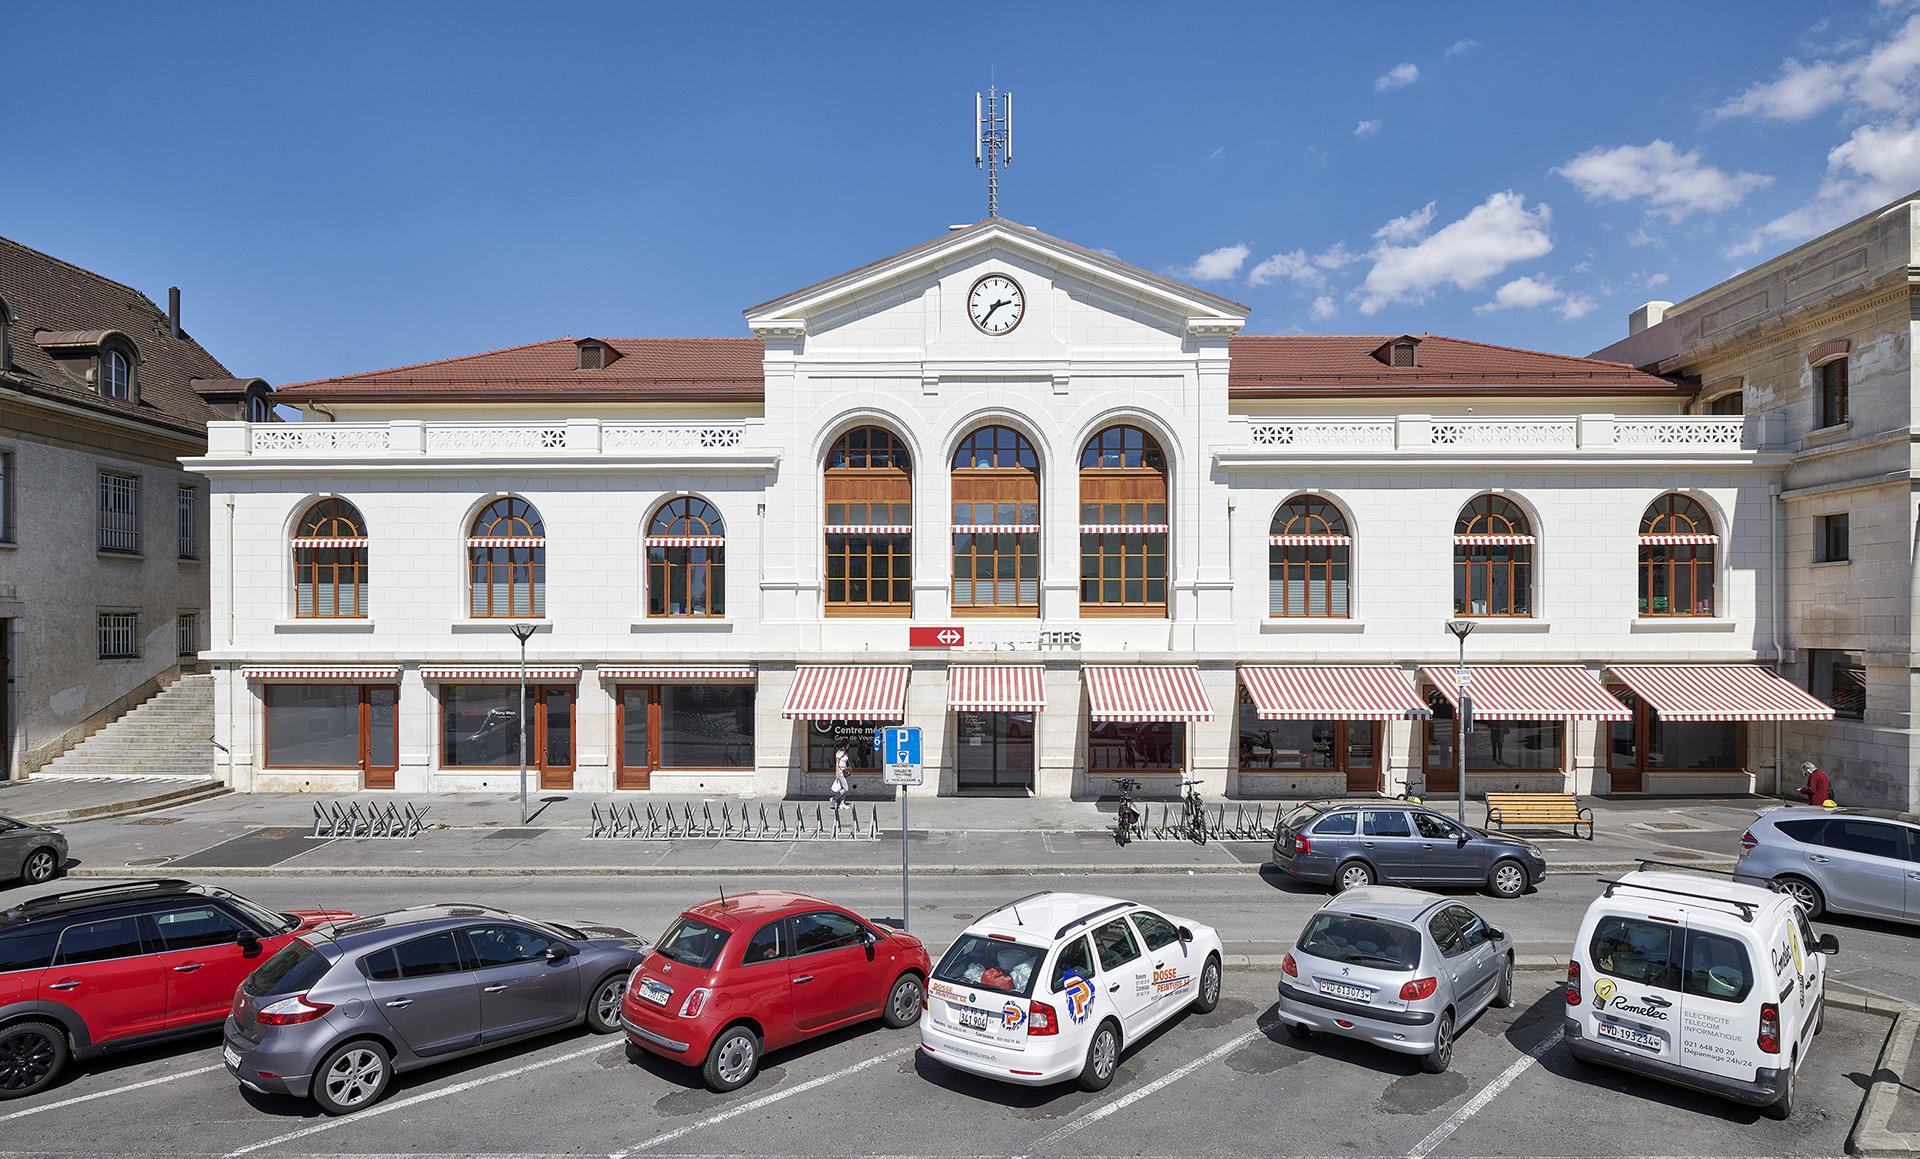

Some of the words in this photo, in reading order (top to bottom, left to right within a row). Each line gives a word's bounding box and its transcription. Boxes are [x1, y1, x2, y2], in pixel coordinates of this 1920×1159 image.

[834, 726, 863, 734] Centre
[865, 725, 884, 734] méd
[897, 729, 909, 750] P
[1609, 995, 1667, 1021] Romelec
[1684, 1011, 1730, 1025] ELECTRICITE
[1684, 1018, 1720, 1030] TELECOM
[1684, 1026, 1742, 1042] INFORMATIQUE
[1684, 1040, 1697, 1049] 021
[1700, 1043, 1713, 1052] 648
[1715, 1046, 1724, 1054] 20
[1726, 1048, 1736, 1056] 20
[1684, 1047, 1725, 1062] Dépannage
[1726, 1055, 1753, 1067] 24h/24
